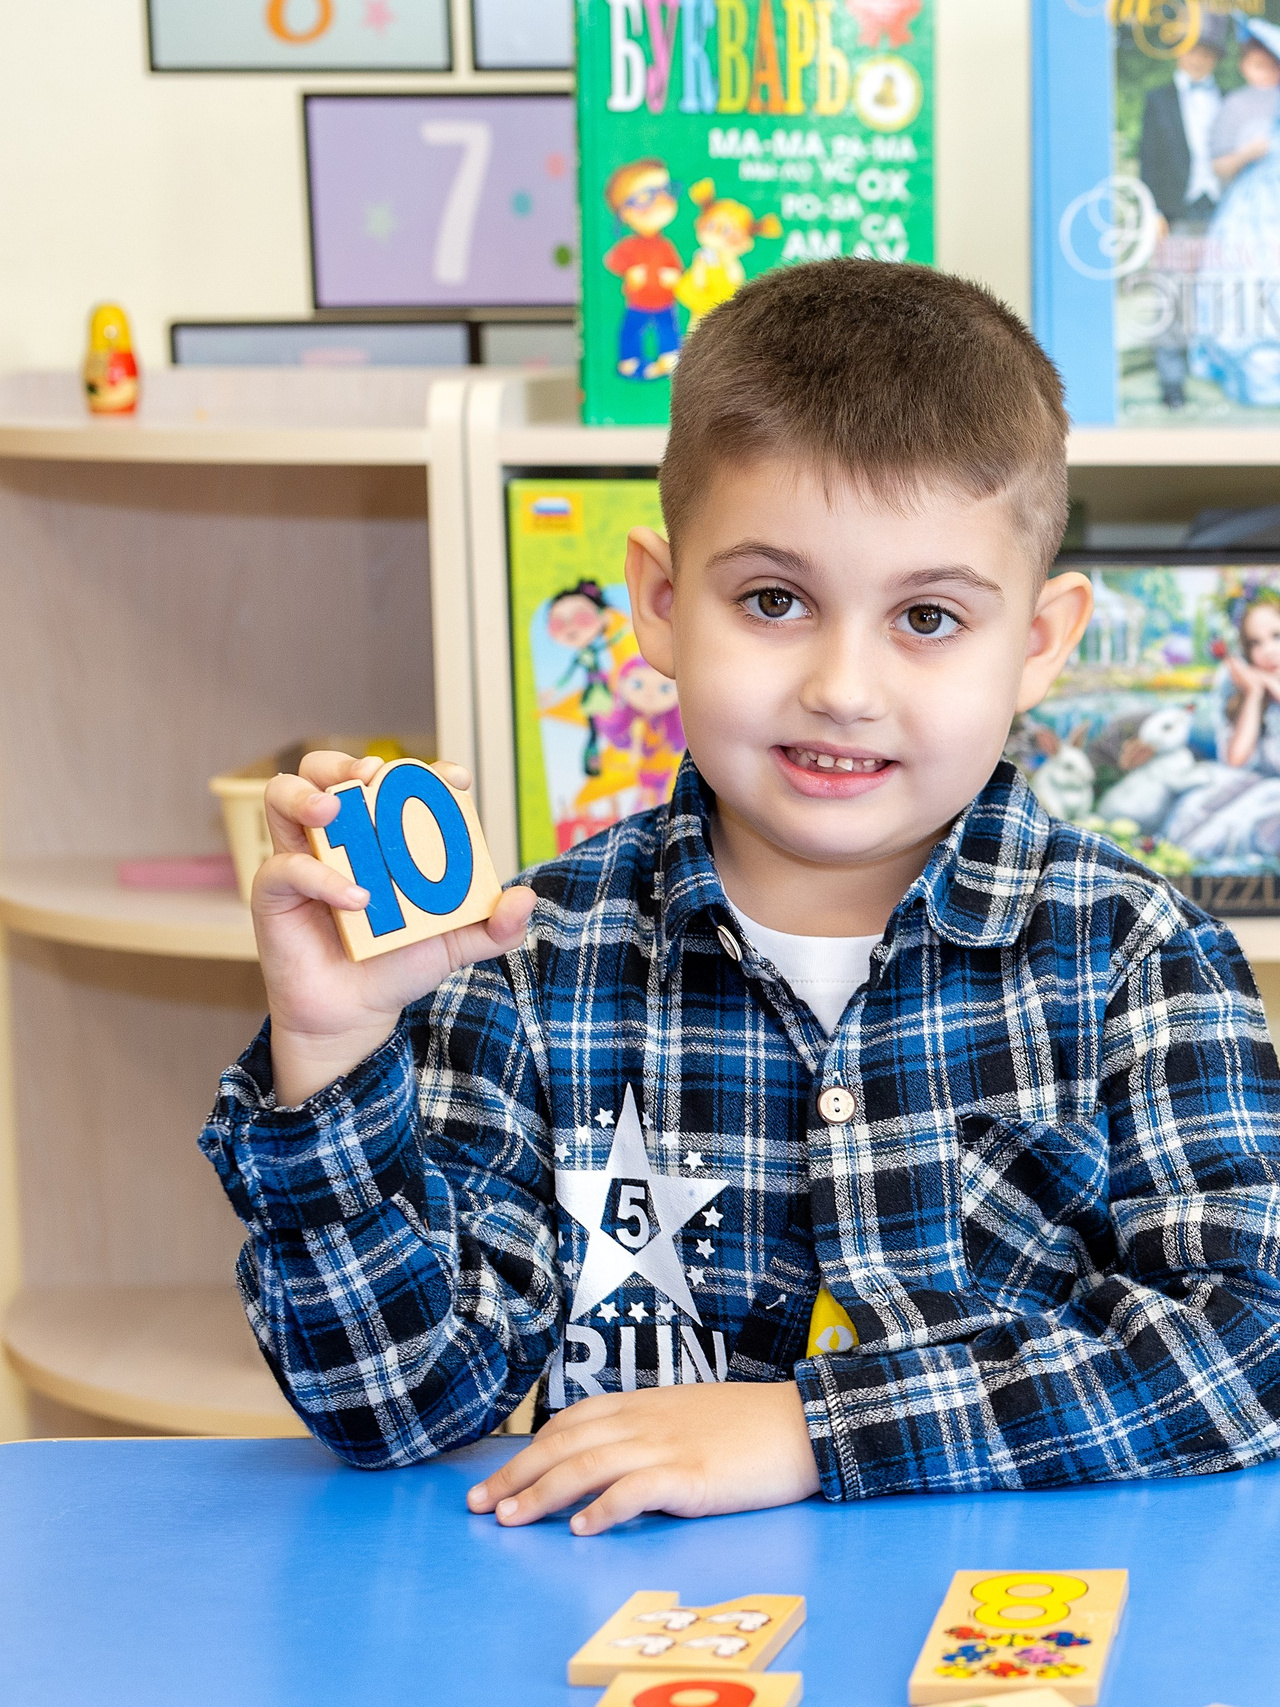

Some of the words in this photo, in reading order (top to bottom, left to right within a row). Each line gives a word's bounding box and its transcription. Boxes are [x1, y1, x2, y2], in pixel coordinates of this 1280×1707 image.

[606, 0, 850, 114] БУКВАРЬ
[420, 121, 492, 285] 7
[323, 763, 474, 938] 10
[615, 1185, 653, 1249] 5
[549, 1323, 728, 1410] RUN
[971, 1573, 1089, 1628] 8
